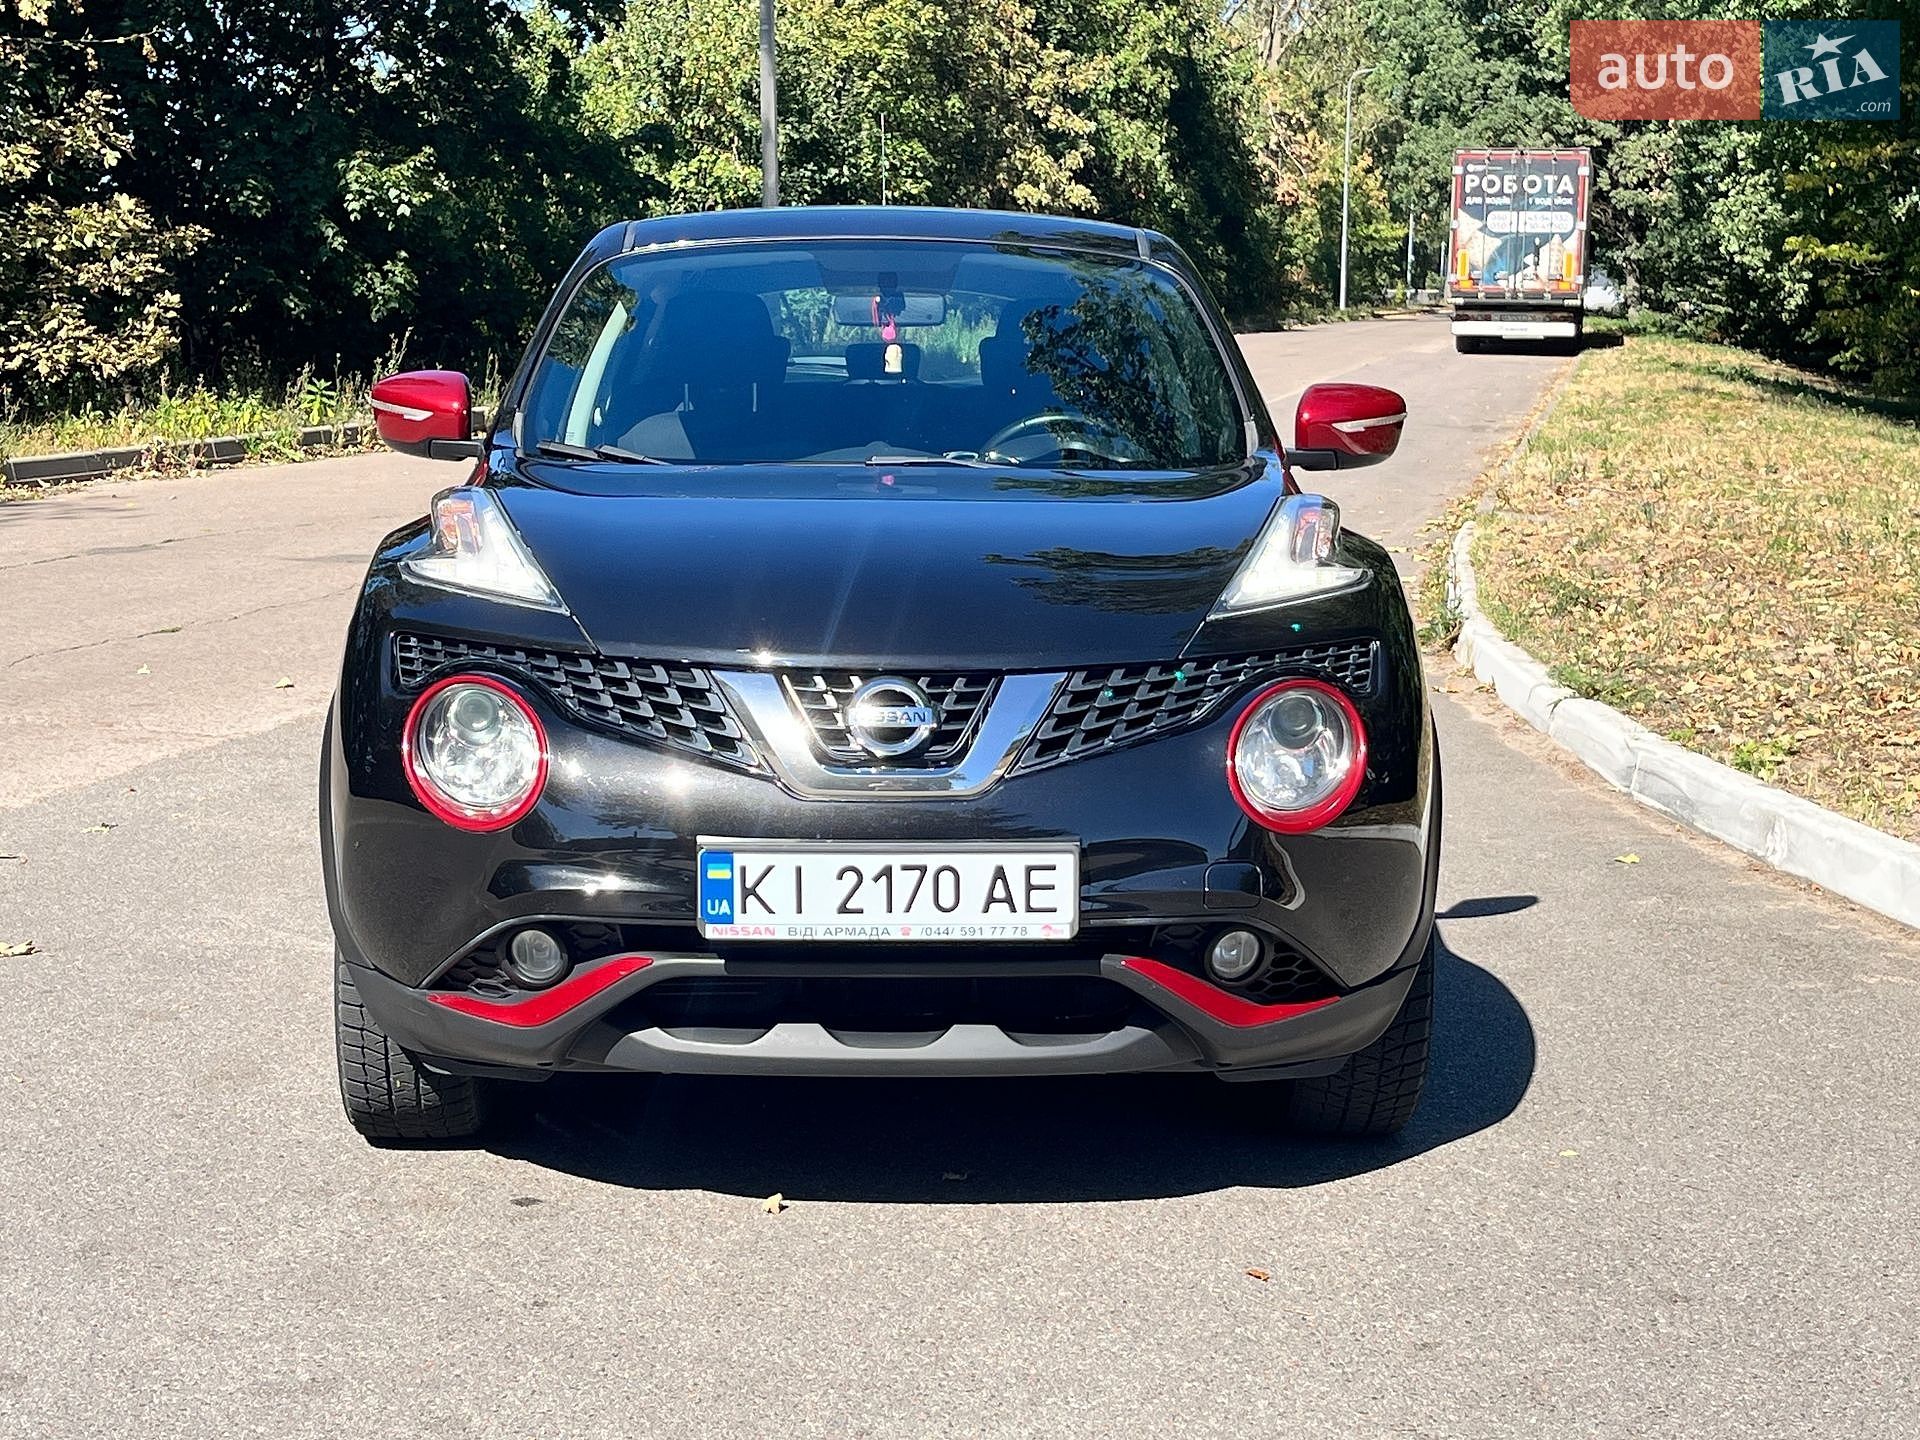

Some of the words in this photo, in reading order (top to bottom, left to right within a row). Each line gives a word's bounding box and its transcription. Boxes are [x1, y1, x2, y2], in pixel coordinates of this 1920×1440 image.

[1464, 174, 1575, 195] РОБОТА
[855, 711, 926, 723] SSAN
[739, 864, 803, 915] KI
[835, 864, 961, 914] 2170
[981, 864, 1058, 914] AE
[706, 899, 732, 916] UA
[712, 926, 776, 937] NISSAN
[823, 926, 892, 940] АРМАДА
[960, 926, 984, 937] 591
[990, 926, 1007, 937] 77
[1012, 926, 1028, 937] 78
